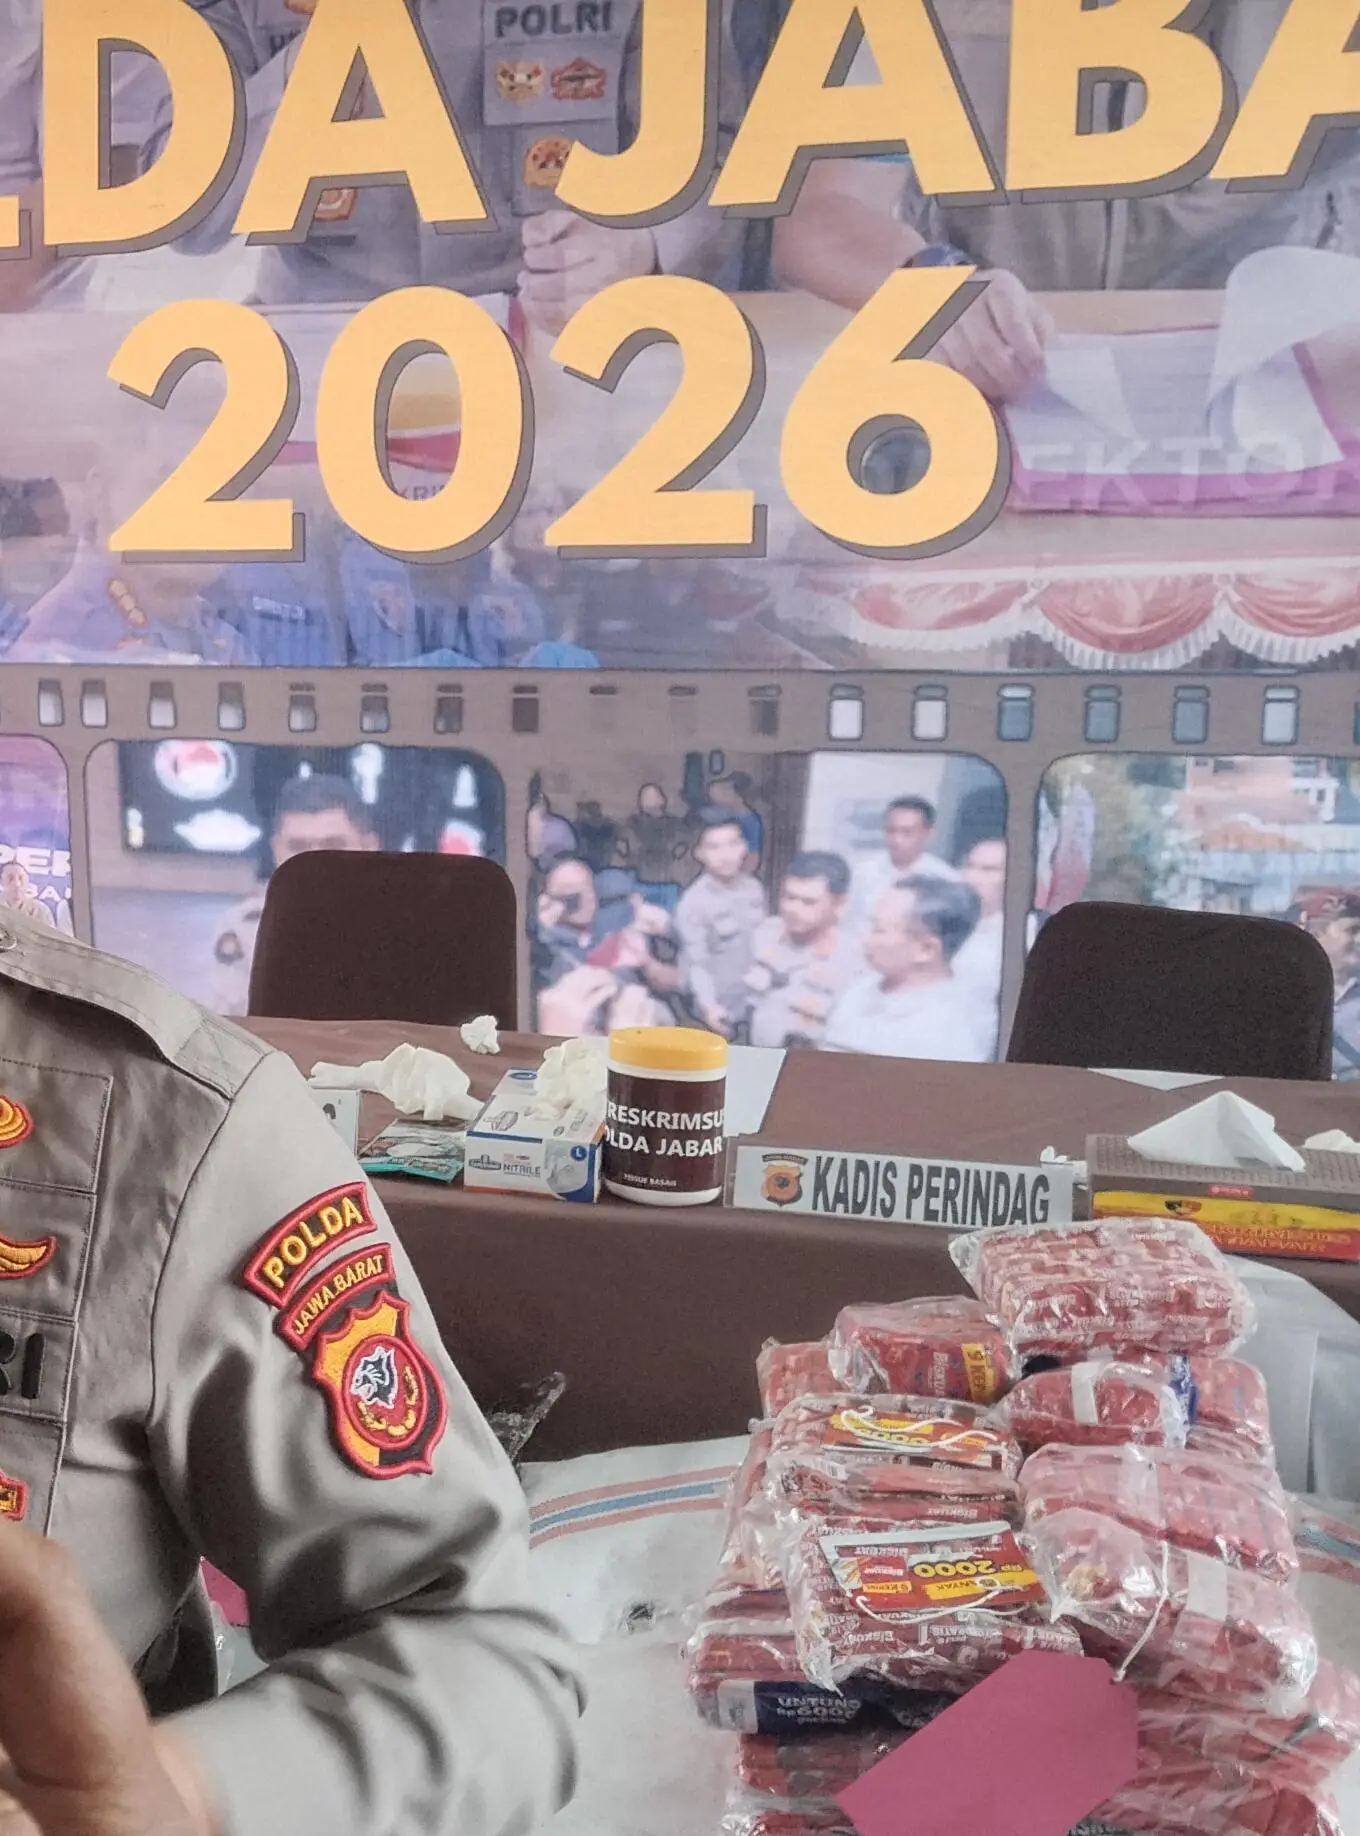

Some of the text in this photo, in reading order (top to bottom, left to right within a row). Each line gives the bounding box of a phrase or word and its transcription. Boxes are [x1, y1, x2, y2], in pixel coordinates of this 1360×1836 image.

[495, 1, 614, 38] POLRI
[108, 265, 999, 552] 2026
[655, 1135, 723, 1157] JABAR
[503, 1163, 541, 1177] NITRILE
[812, 1155, 1050, 1228] KADIS PERINDAG
[262, 1196, 365, 1289] POLDA
[913, 1559, 996, 1579] 2000
